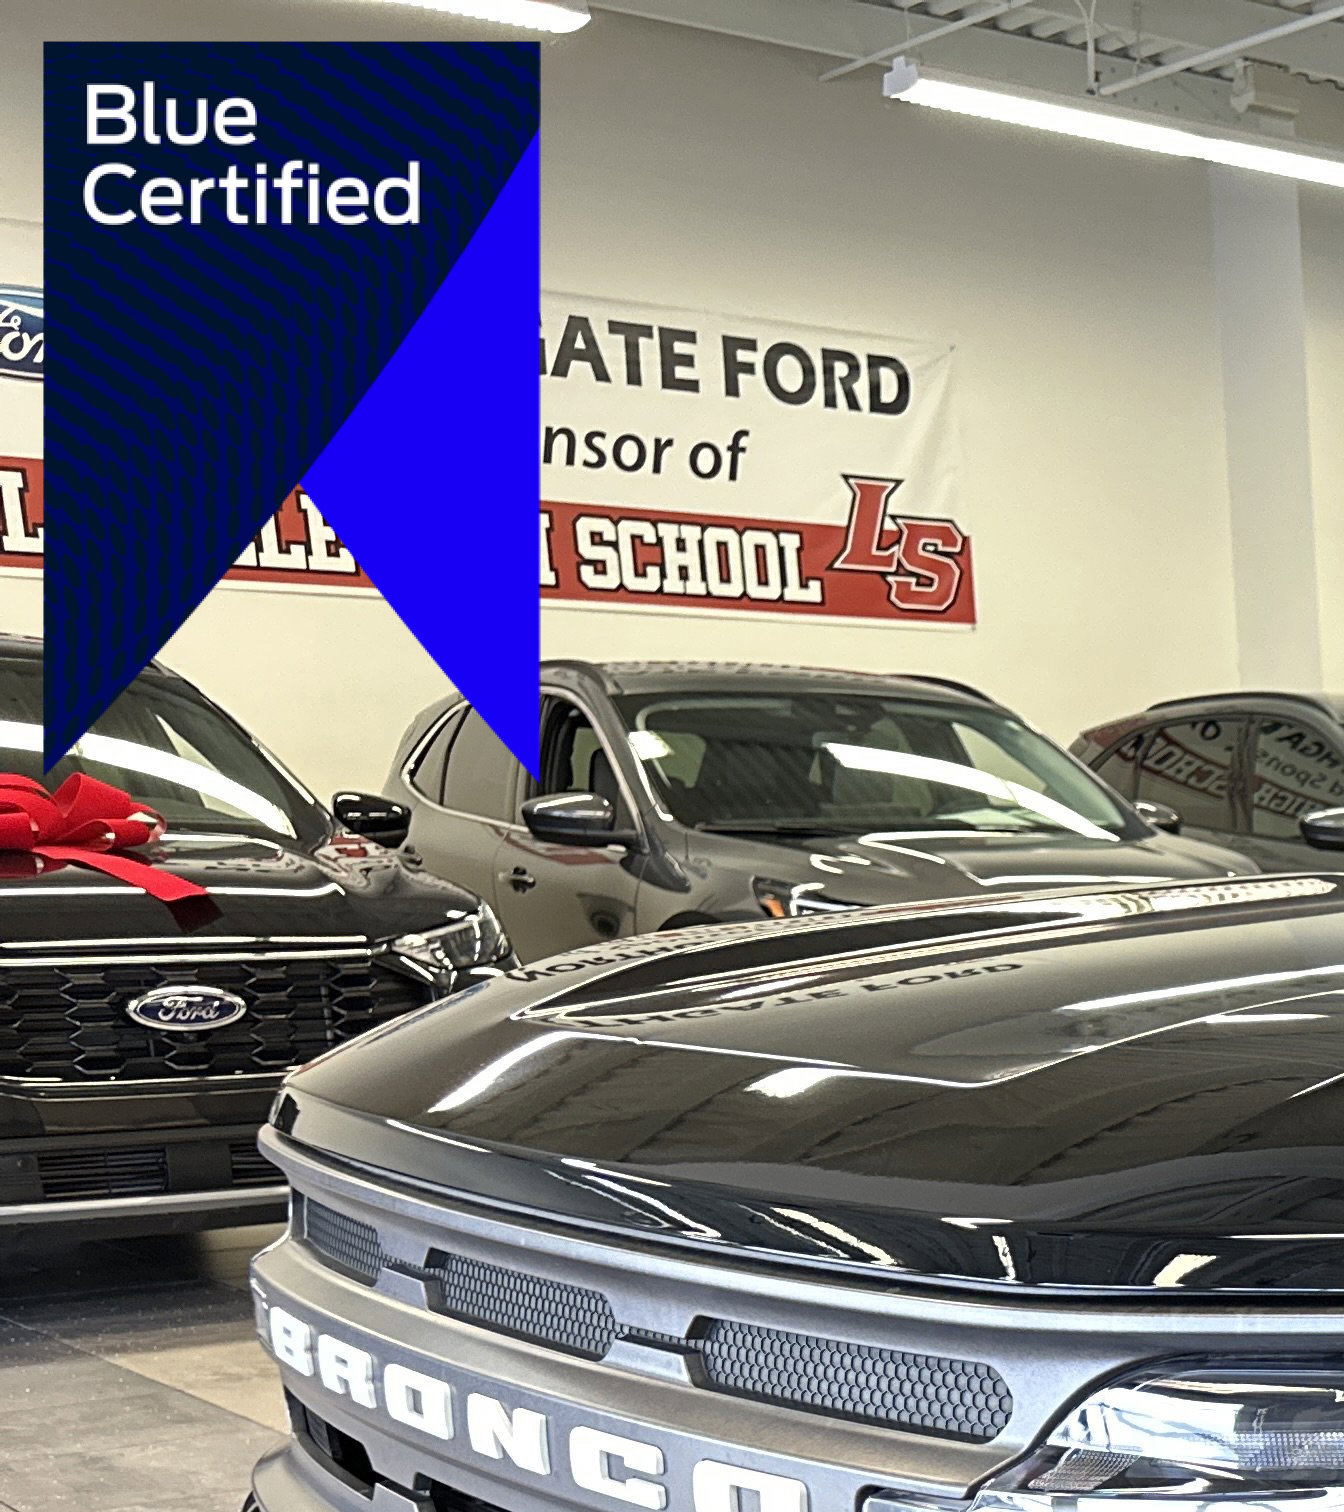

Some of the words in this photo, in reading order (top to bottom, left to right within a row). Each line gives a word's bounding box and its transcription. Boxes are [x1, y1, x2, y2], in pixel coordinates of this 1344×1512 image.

[540, 312, 701, 394] ATE
[721, 334, 912, 416] FORD
[688, 429, 750, 483] of
[573, 513, 824, 604] SCHOOL
[826, 473, 969, 613] LS
[158, 995, 220, 1022] Ford
